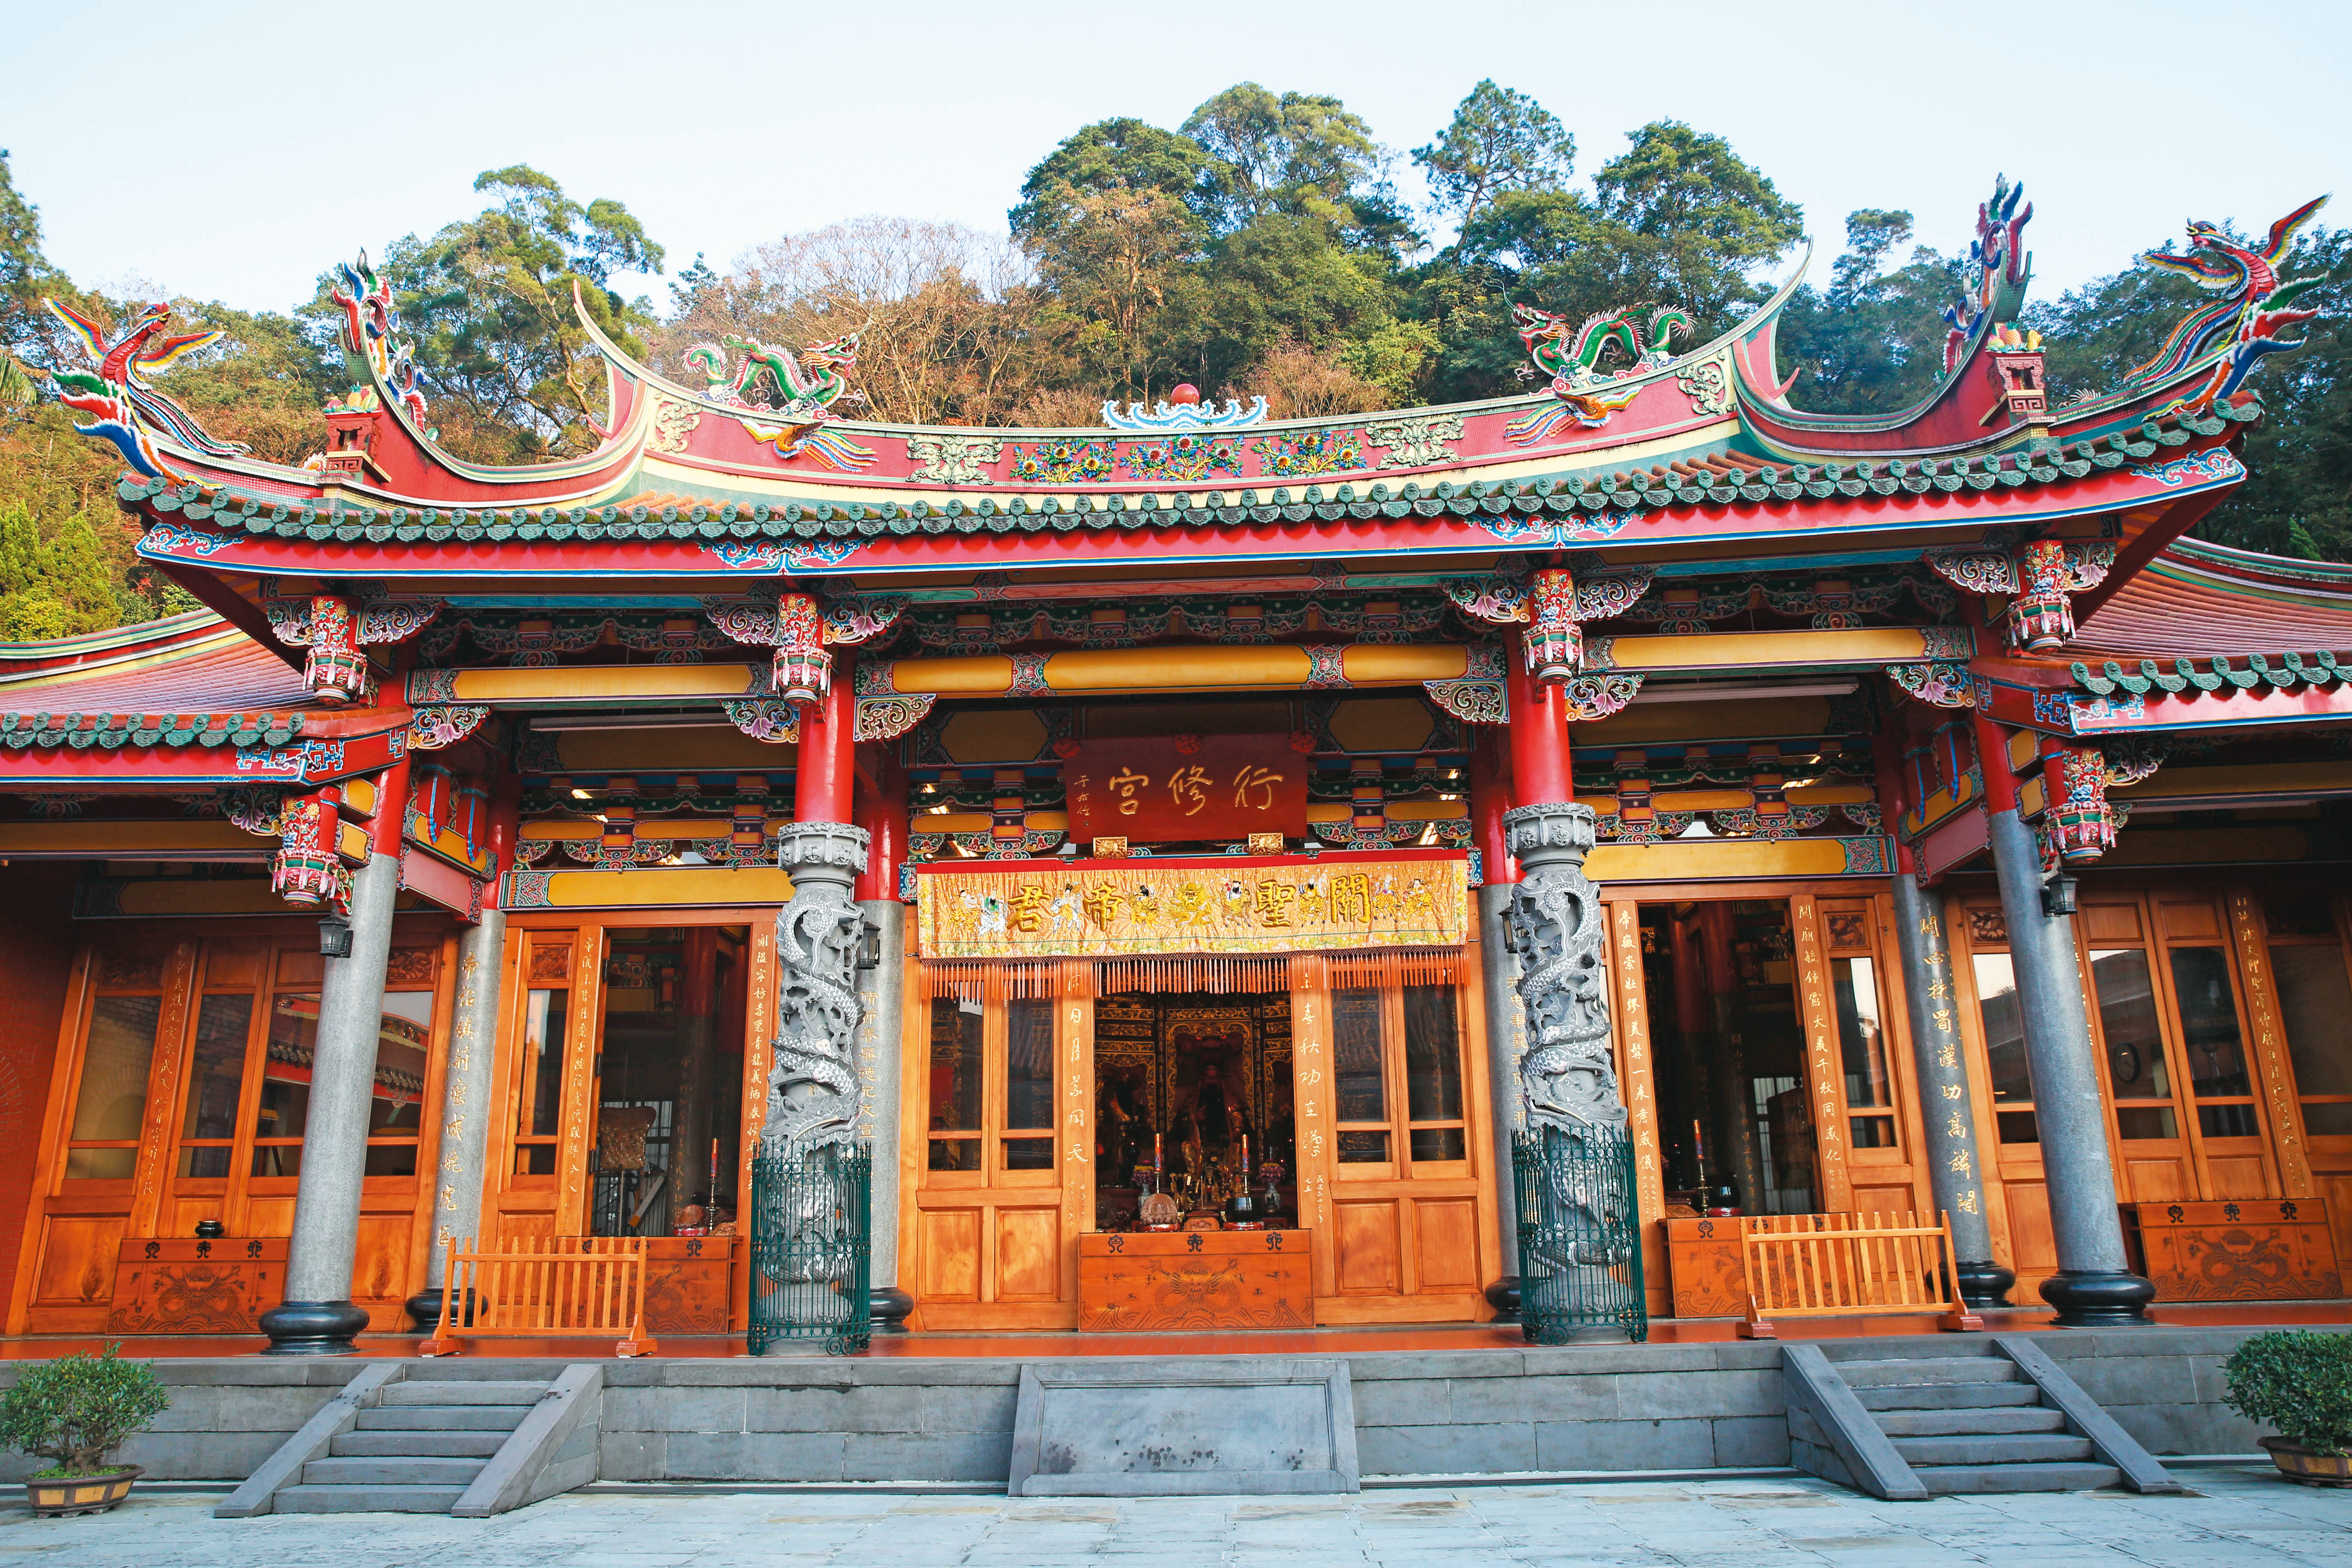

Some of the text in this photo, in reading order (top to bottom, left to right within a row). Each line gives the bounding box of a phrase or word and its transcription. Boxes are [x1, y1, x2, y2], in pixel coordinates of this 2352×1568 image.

[1006, 871, 1372, 933] 關聖帝君
[1300, 955, 1323, 1157] 春秋功在漢
